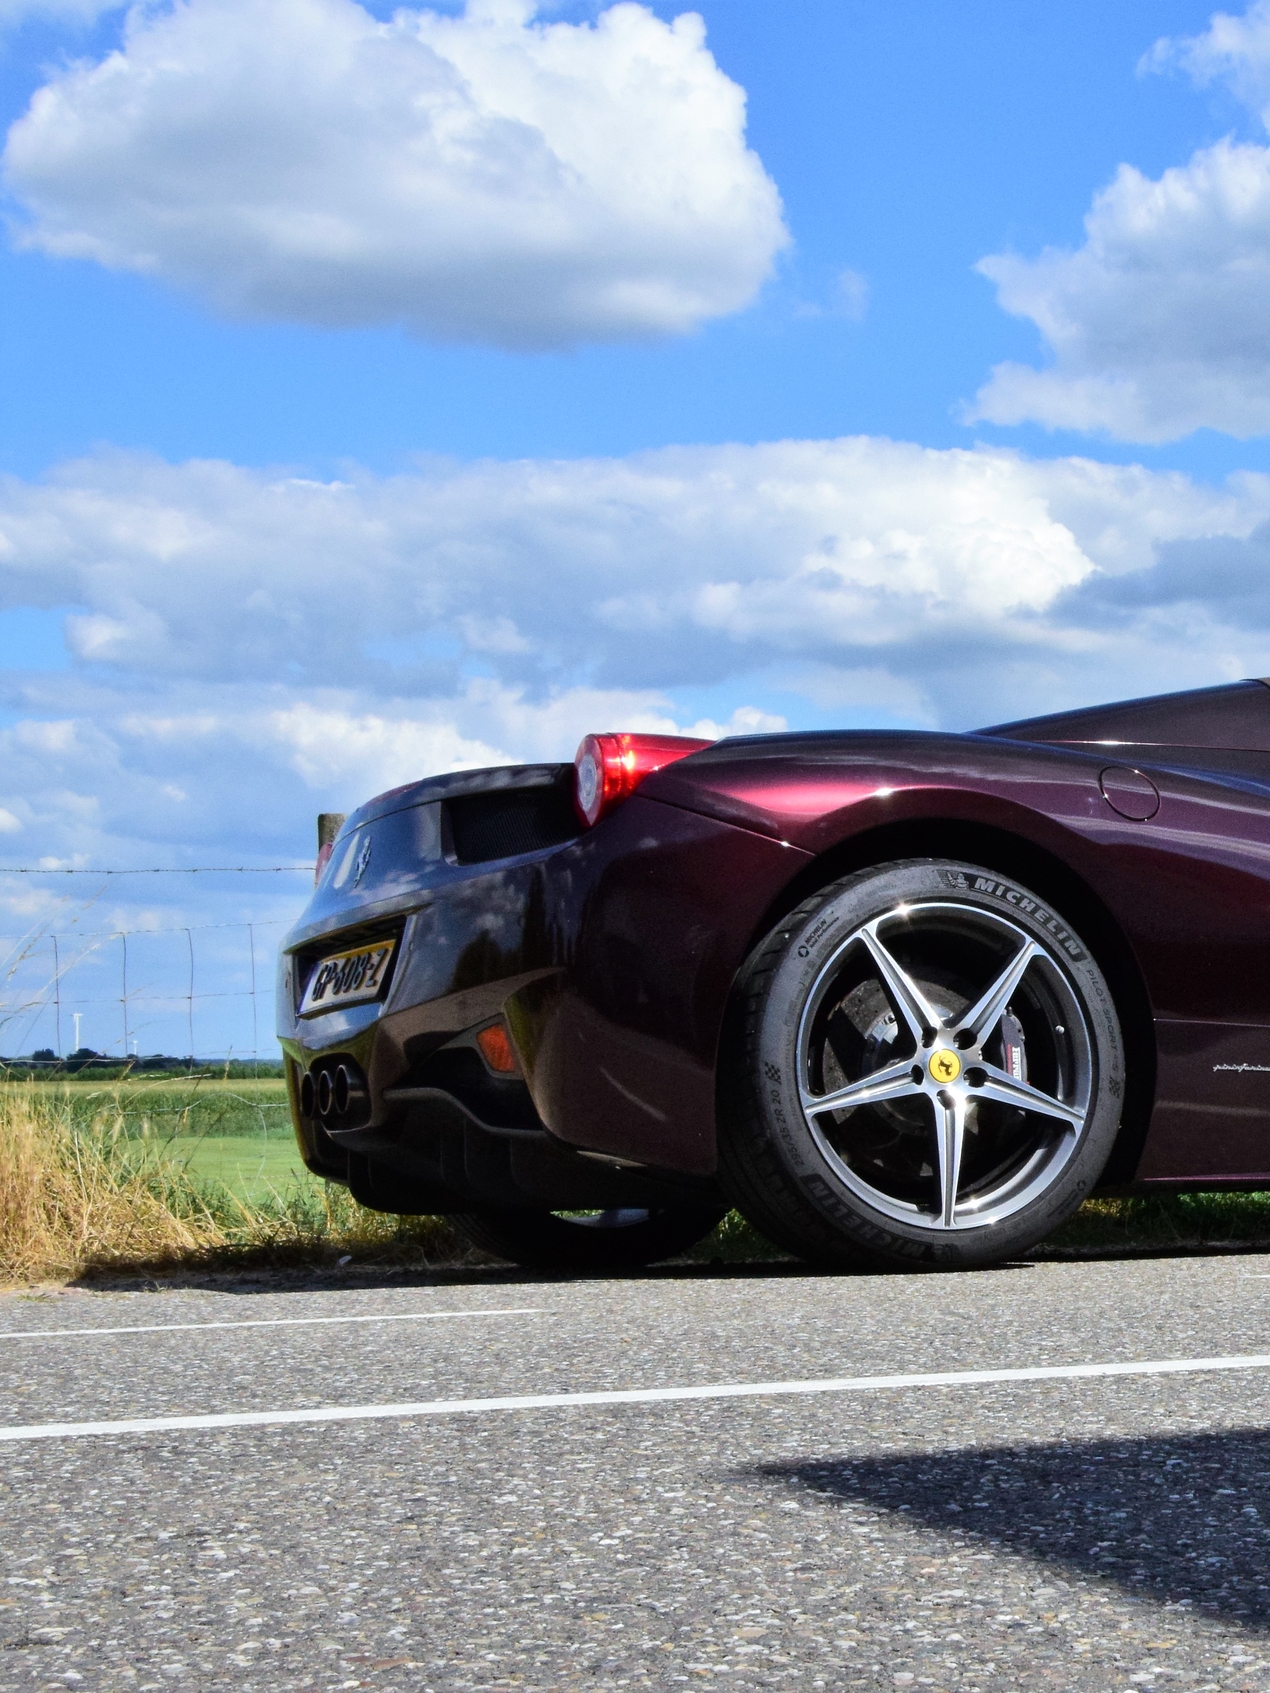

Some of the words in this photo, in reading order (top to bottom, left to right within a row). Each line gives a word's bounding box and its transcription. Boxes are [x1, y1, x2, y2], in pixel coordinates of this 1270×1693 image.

[974, 877, 1082, 955] MICHELIN
[1086, 969, 1107, 1003] PILOT
[1102, 1008, 1119, 1052] SPORT
[1012, 1046, 1022, 1081] Ferrar
[771, 1089, 782, 1106] 20
[774, 1109, 787, 1124] ZR
[780, 1126, 806, 1167] 295/35
[809, 1180, 927, 1258] MICHELIN
